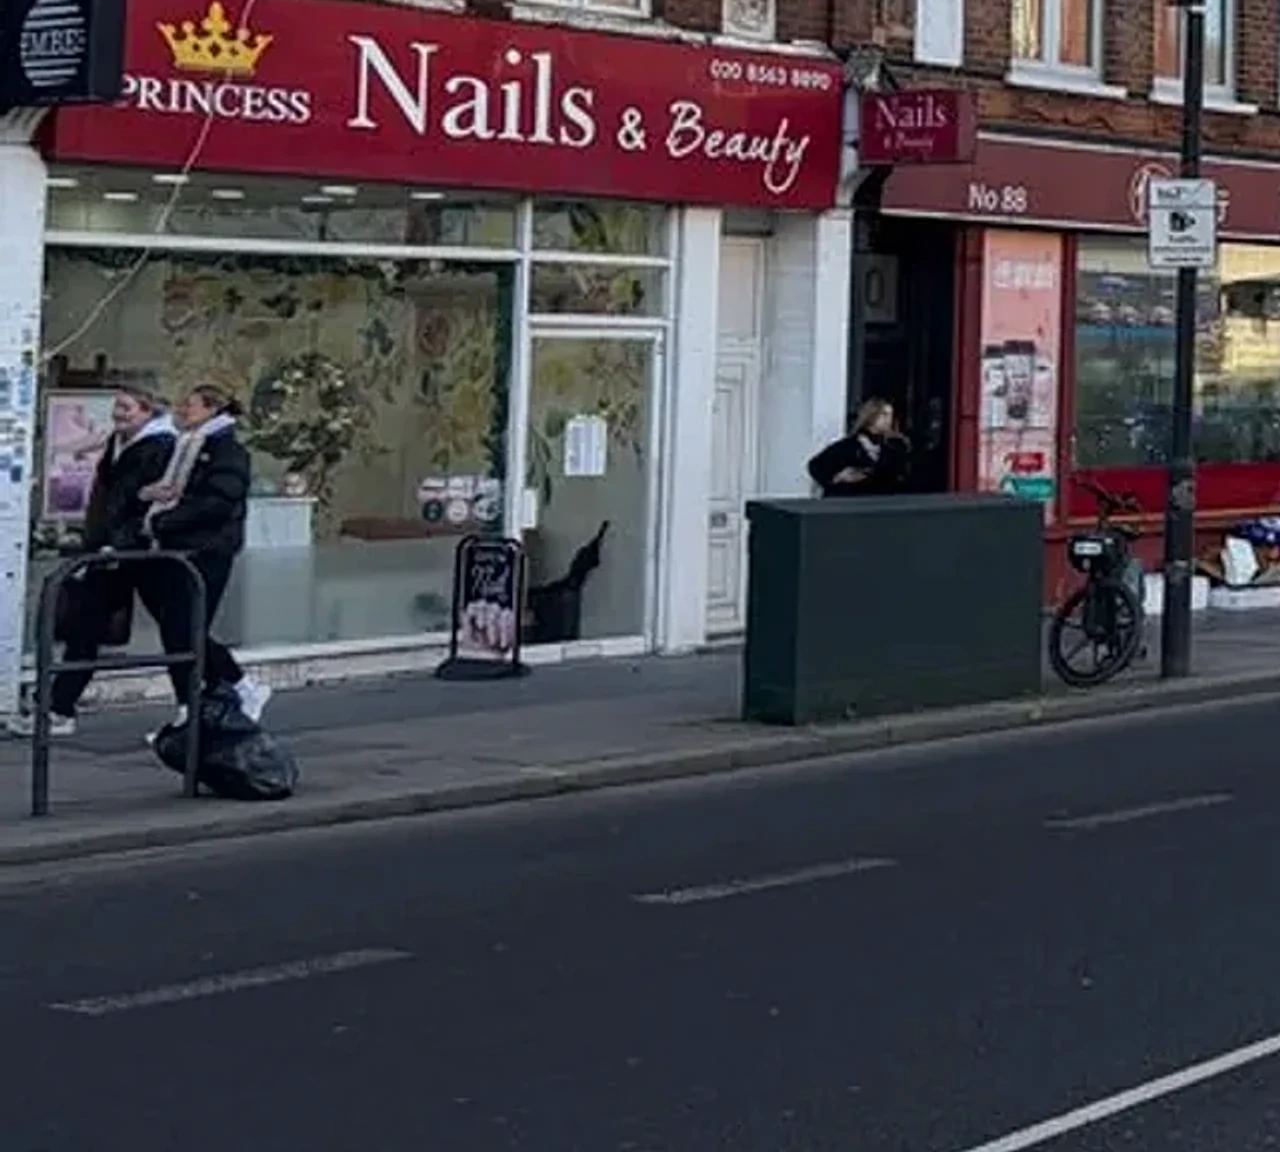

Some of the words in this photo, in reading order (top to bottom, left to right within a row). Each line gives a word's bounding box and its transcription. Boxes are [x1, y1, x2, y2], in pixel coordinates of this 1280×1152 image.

[709, 59, 742, 80] 020
[346, 34, 597, 148] Nails
[616, 107, 646, 152] &
[665, 100, 811, 195] Beauty
[875, 95, 949, 129] Nails
[1001, 185, 1028, 212] 88
